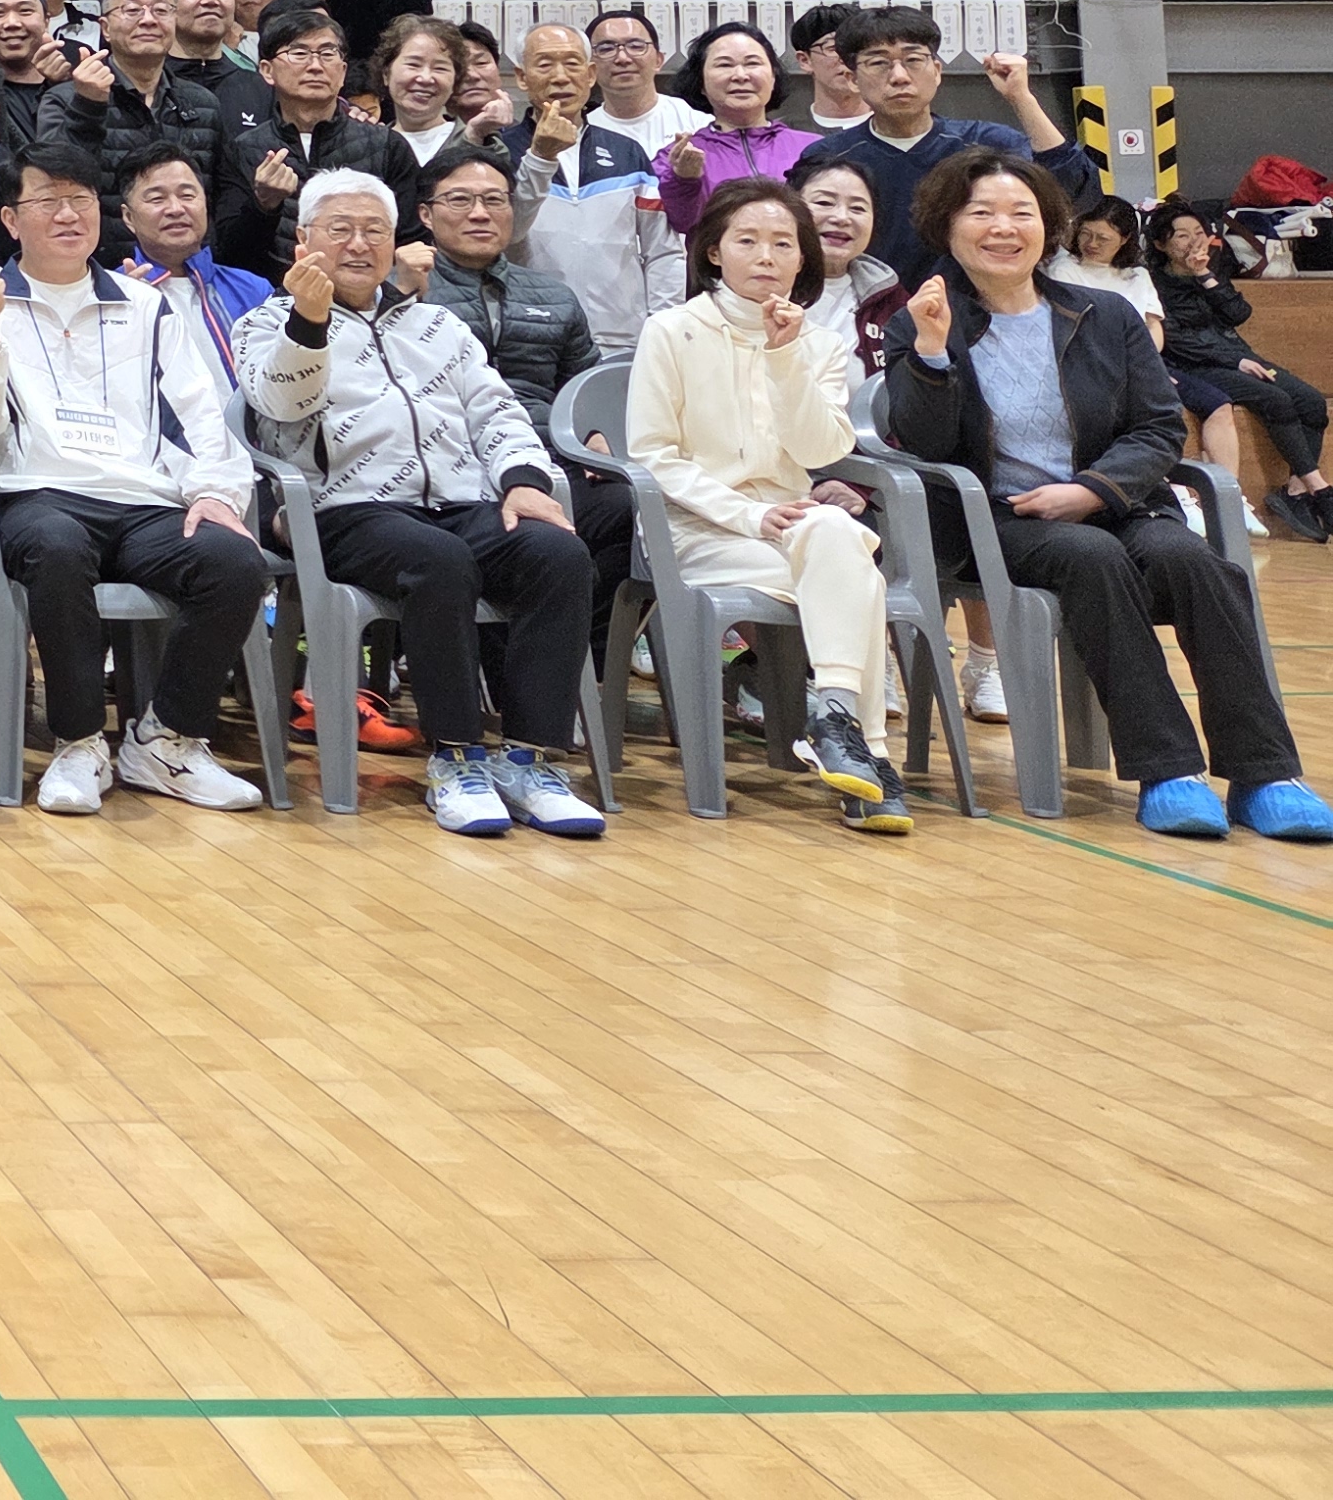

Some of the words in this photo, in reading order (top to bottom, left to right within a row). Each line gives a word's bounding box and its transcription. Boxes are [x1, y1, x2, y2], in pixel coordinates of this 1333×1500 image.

[418, 326, 438, 343] THE
[355, 348, 373, 367] THE
[333, 421, 353, 443] THE
[312, 474, 352, 509] NORTH
